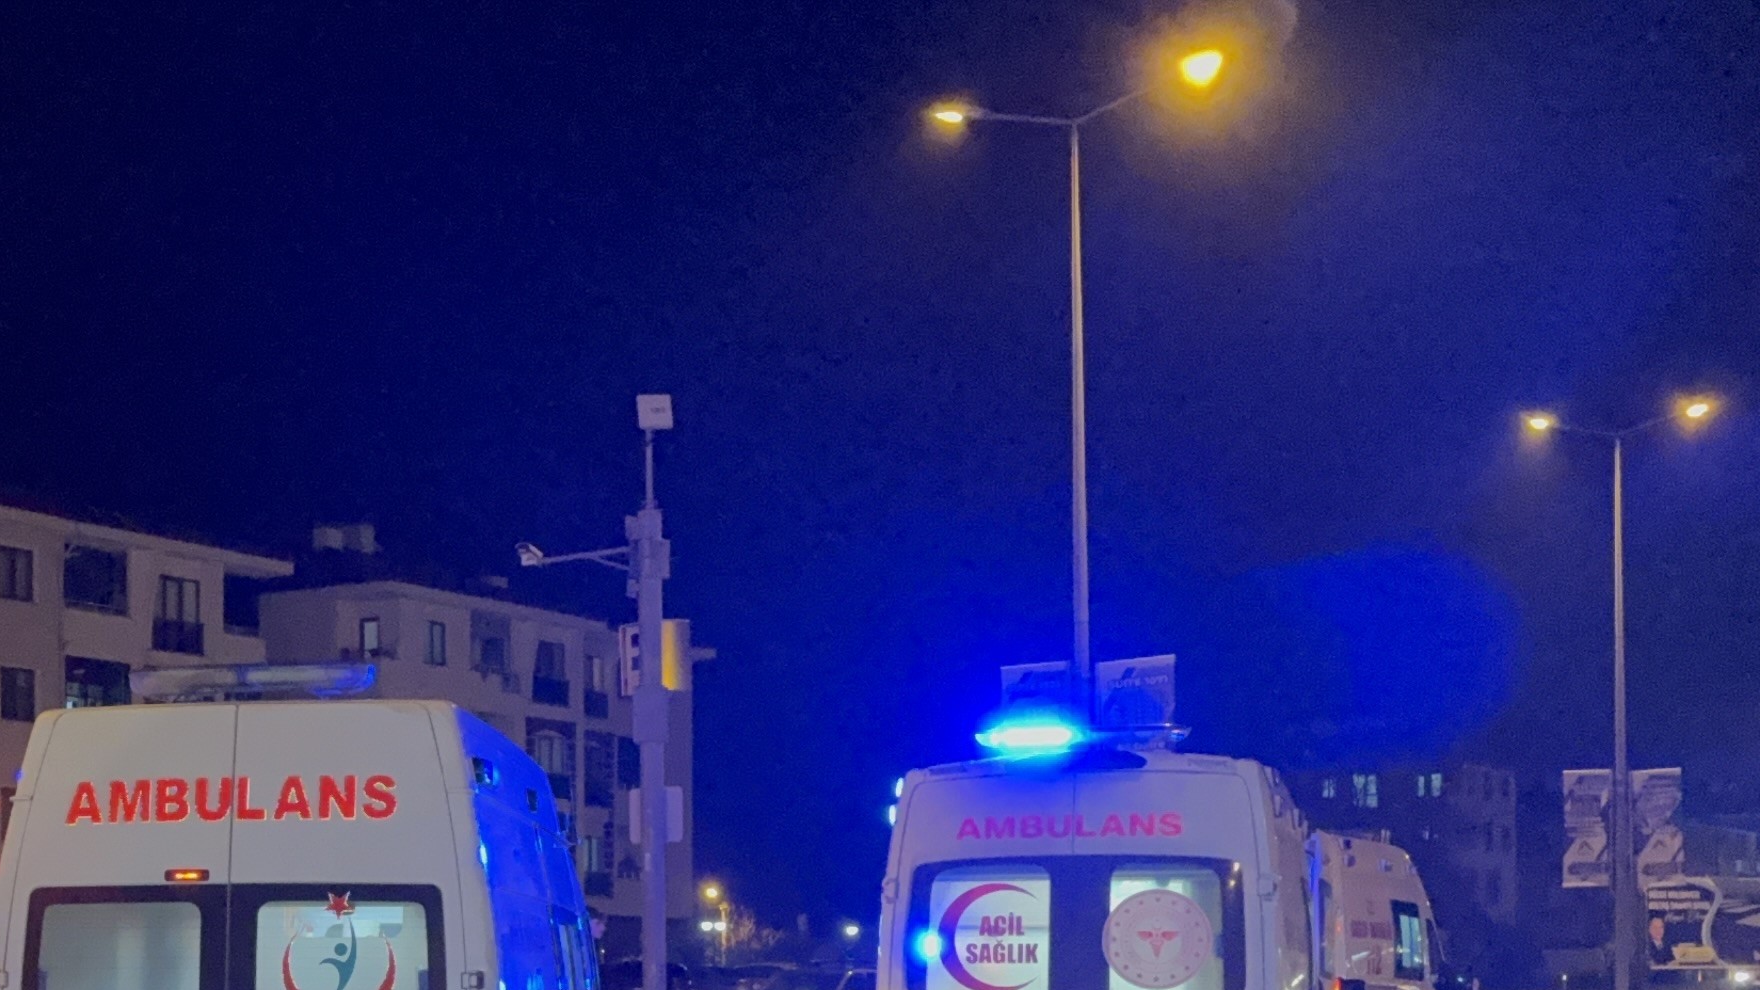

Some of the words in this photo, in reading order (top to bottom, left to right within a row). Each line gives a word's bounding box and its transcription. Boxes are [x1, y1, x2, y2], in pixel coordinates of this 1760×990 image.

[65, 774, 397, 826] AMBULANS
[956, 811, 1183, 841] AMBULANS
[978, 911, 1025, 937] ACİL
[965, 939, 1039, 964] SAĞLIK
